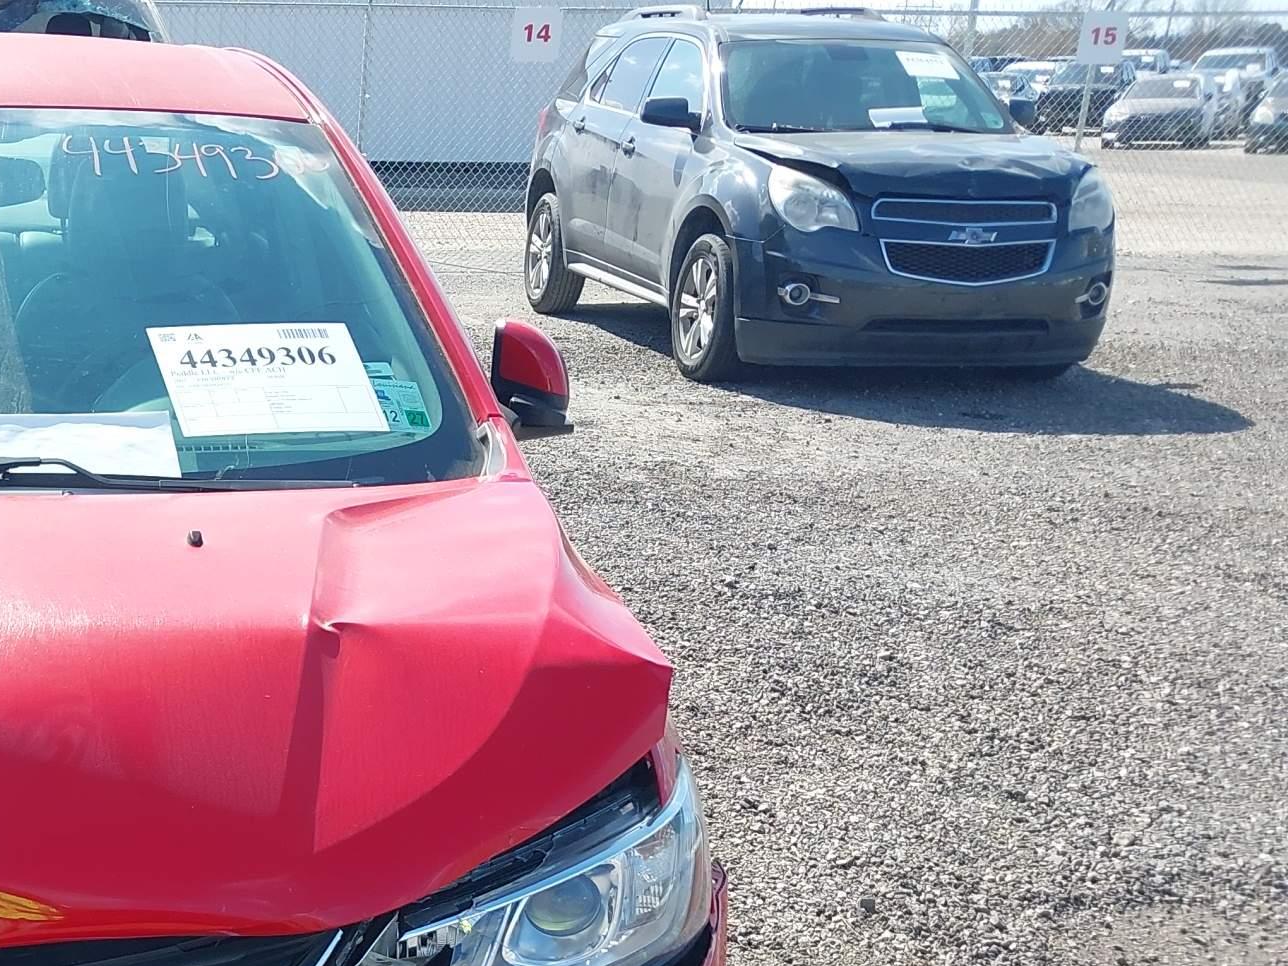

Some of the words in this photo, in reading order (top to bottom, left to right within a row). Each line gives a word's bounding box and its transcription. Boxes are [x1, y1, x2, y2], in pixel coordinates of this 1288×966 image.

[524, 23, 552, 42] 14
[1091, 26, 1118, 46] 15
[179, 345, 337, 369] 44349306
[383, 410, 400, 423] 12
